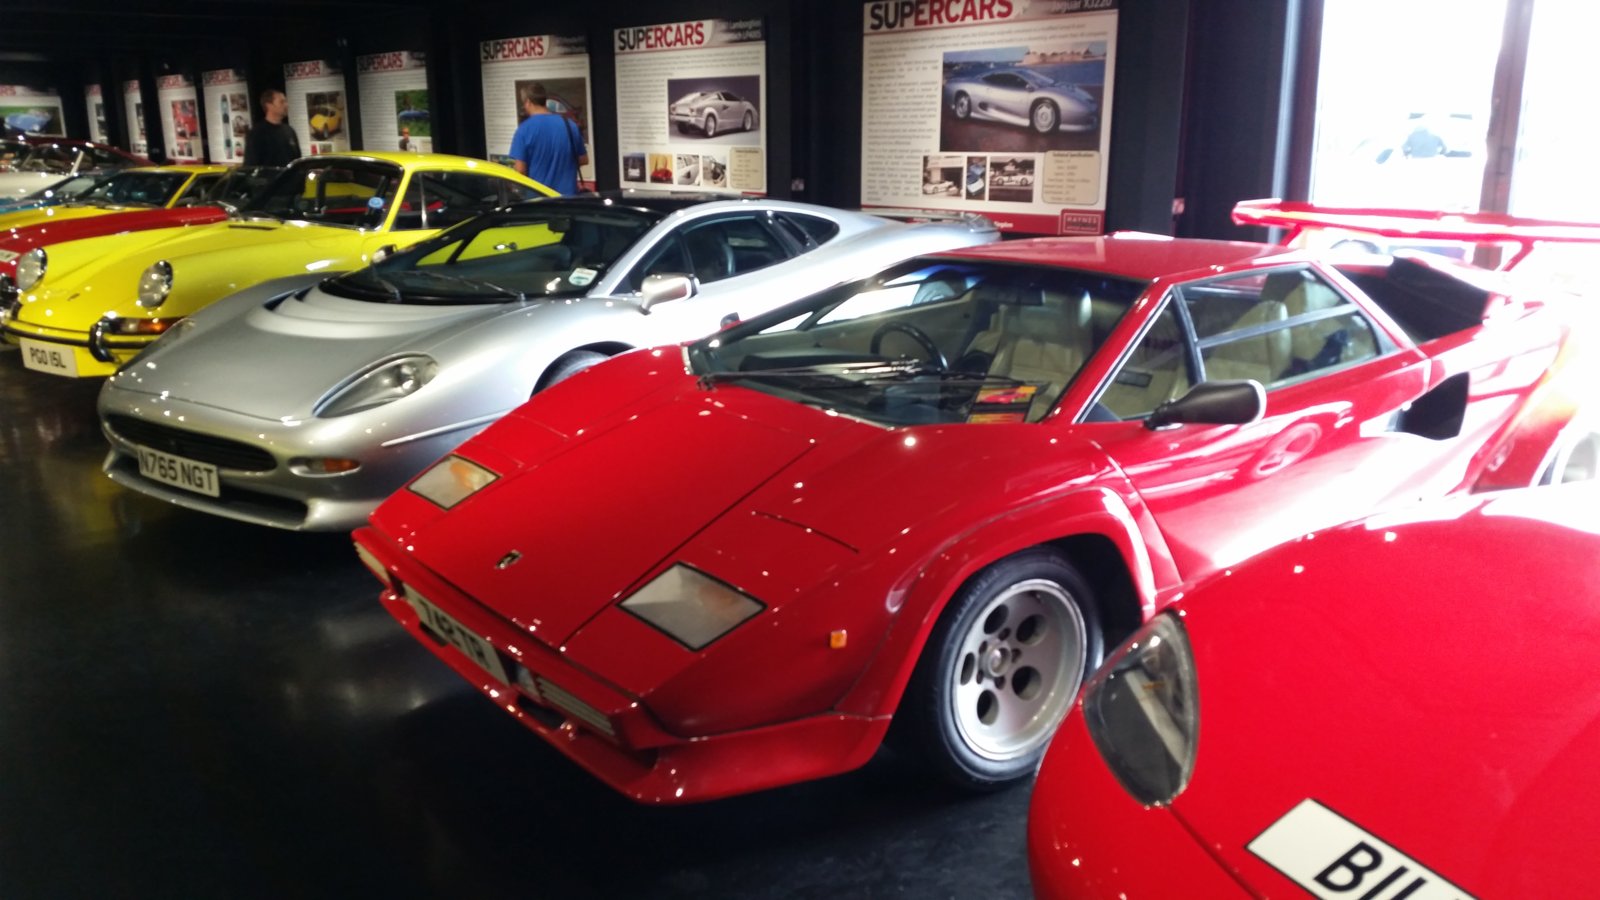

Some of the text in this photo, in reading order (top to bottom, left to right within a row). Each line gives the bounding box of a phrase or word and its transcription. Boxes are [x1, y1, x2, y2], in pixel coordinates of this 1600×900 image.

[869, 0, 1014, 31] SUPERCARS
[482, 37, 544, 60] SUPERCARS
[617, 21, 705, 50] SUPERCARS
[357, 52, 404, 72] SUPERCARS
[139, 449, 215, 491] N765 NGT
